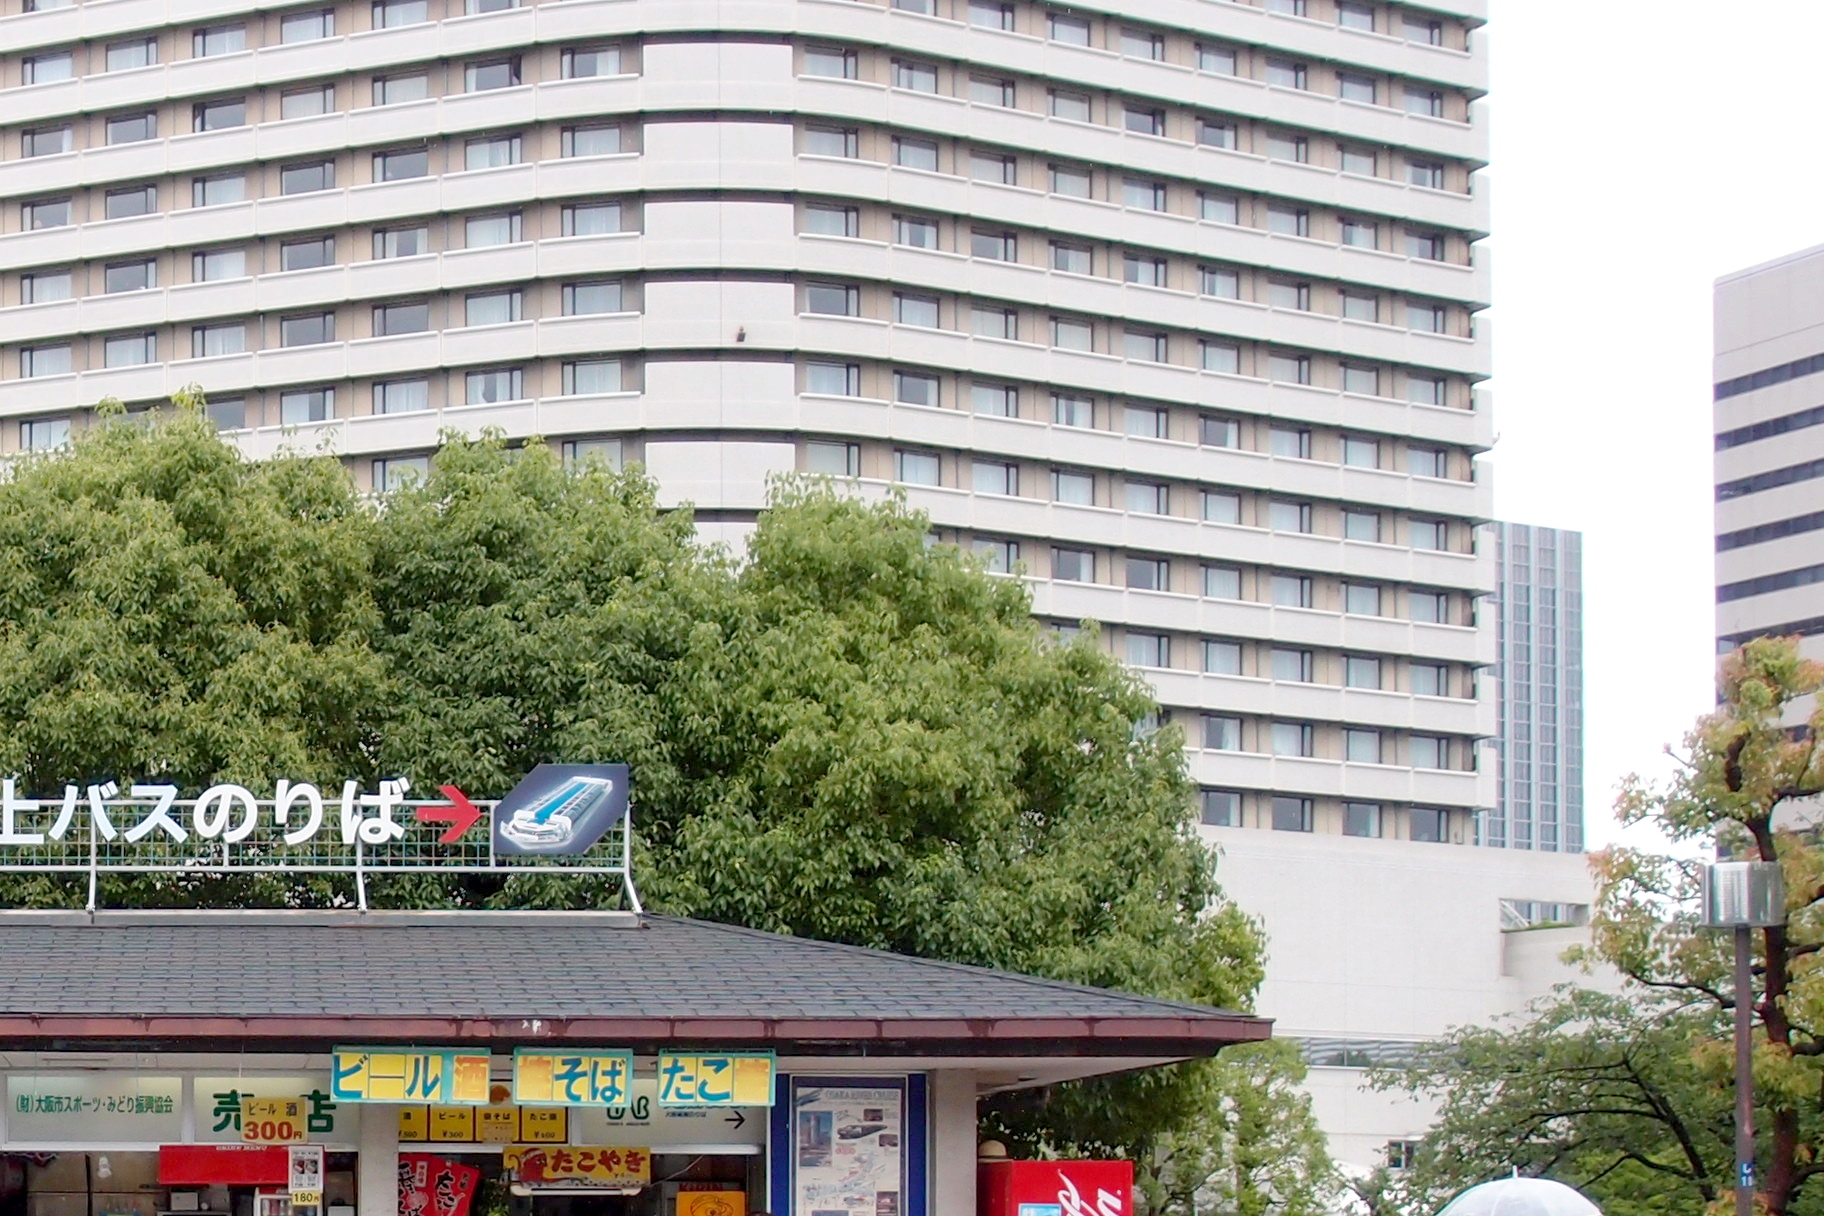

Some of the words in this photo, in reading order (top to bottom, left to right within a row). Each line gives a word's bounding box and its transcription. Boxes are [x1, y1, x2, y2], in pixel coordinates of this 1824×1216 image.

[333, 1054, 440, 1099] ビール
[454, 1055, 489, 1099] 酒
[519, 1056, 625, 1102] そば
[661, 1058, 768, 1100] たこ
[248, 1102, 277, 1116] ビール
[286, 1102, 297, 1116] 酒
[439, 1112, 466, 1121] ビール
[244, 1121, 302, 1140] 300円
[551, 1149, 646, 1173] たこやき
